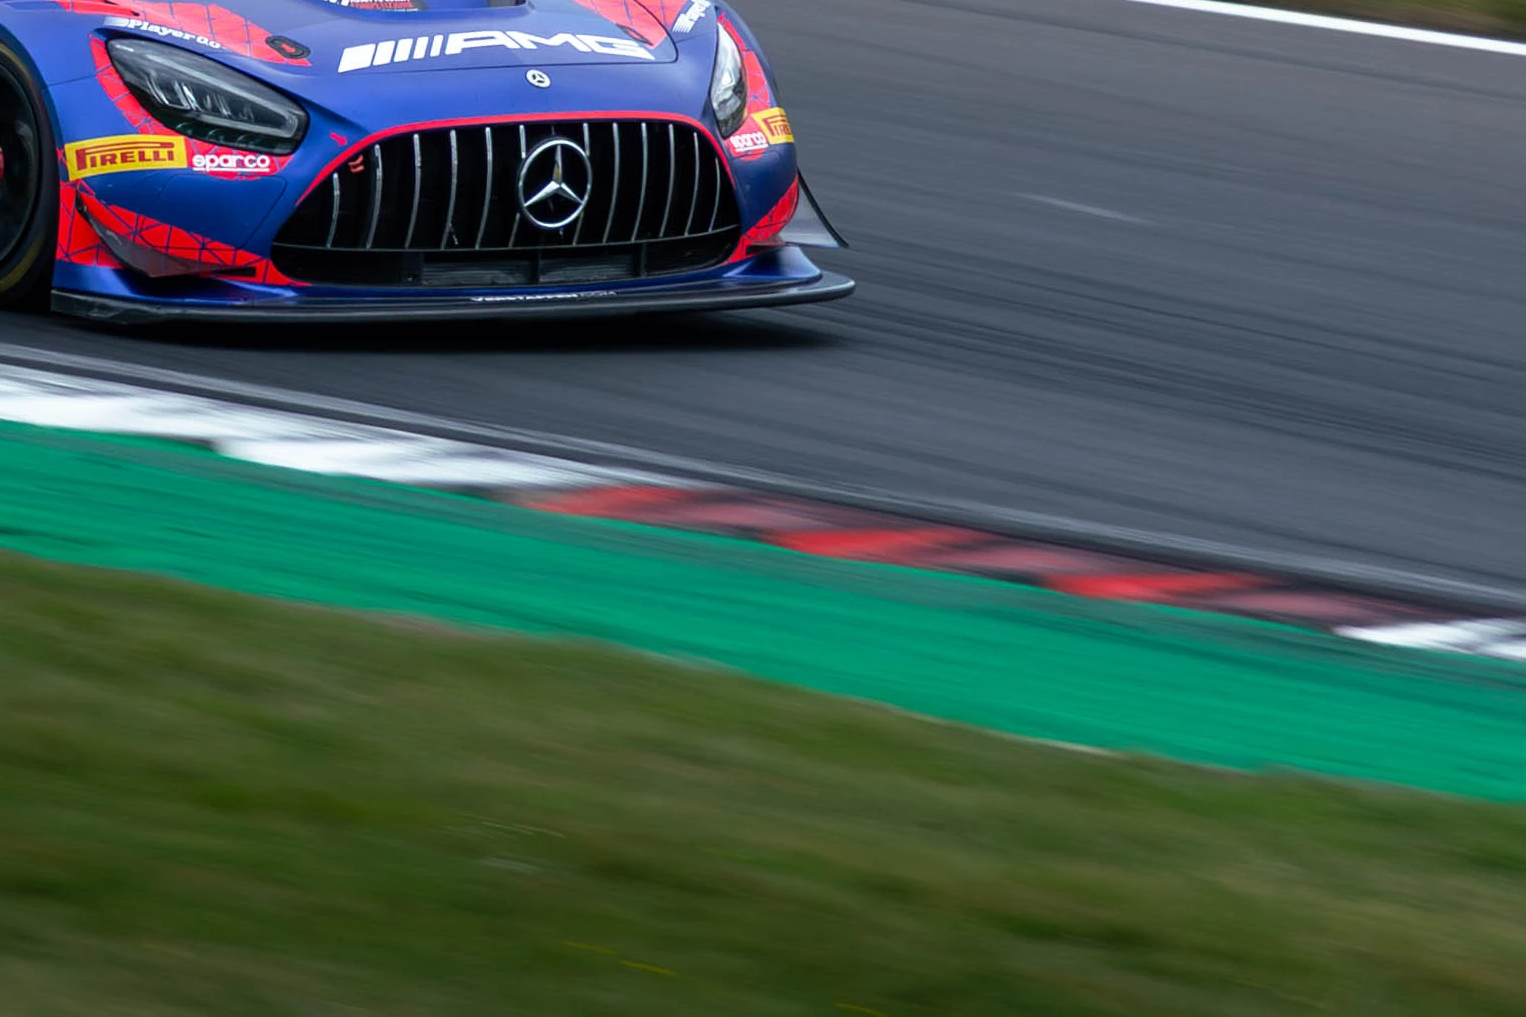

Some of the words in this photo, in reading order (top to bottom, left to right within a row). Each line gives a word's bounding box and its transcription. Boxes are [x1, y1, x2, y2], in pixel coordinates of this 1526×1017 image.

[441, 29, 656, 61] AMG
[74, 140, 176, 172] PIRELLI
[191, 153, 271, 173] sparco
